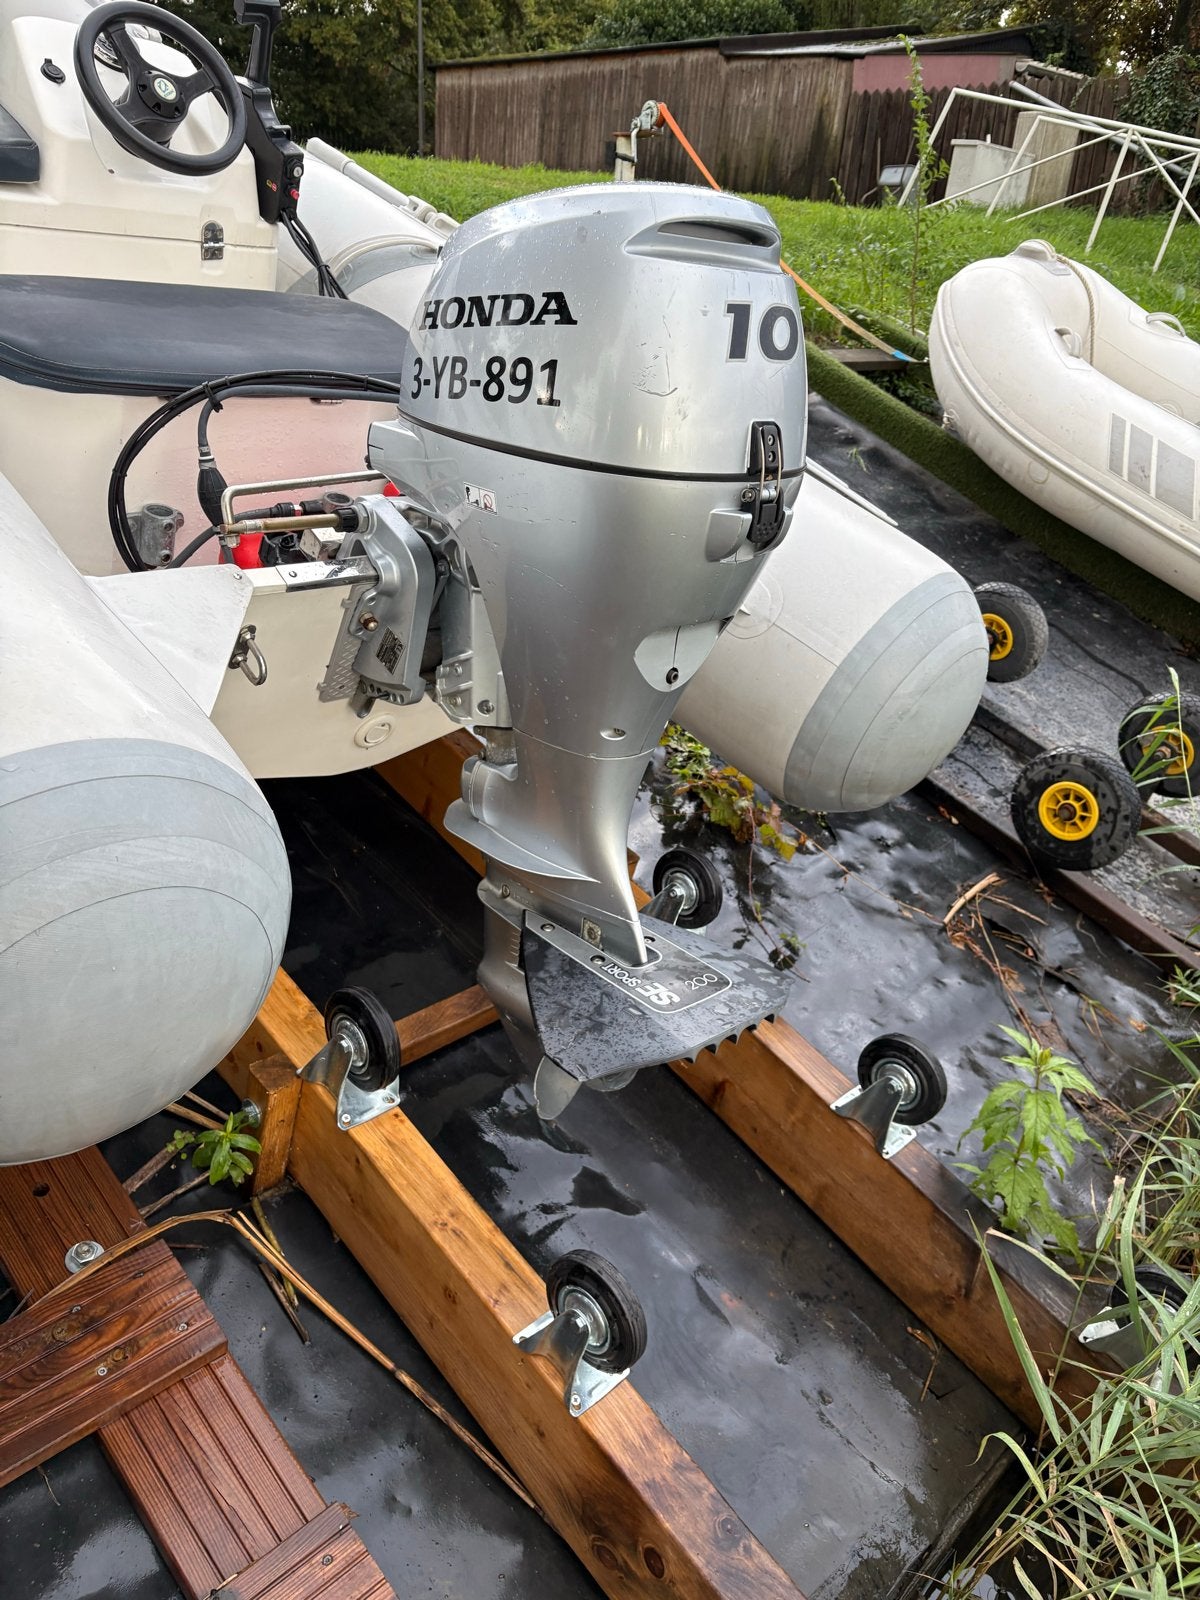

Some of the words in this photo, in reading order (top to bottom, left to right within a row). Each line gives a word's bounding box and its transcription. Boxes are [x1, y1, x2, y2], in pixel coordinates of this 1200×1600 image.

[419, 291, 578, 331] HONDA
[725, 301, 799, 362] 10
[411, 355, 561, 407] 3-YB-891
[601, 963, 642, 987] SPORT
[684, 973, 718, 990] 200
[635, 982, 681, 1006] SE
